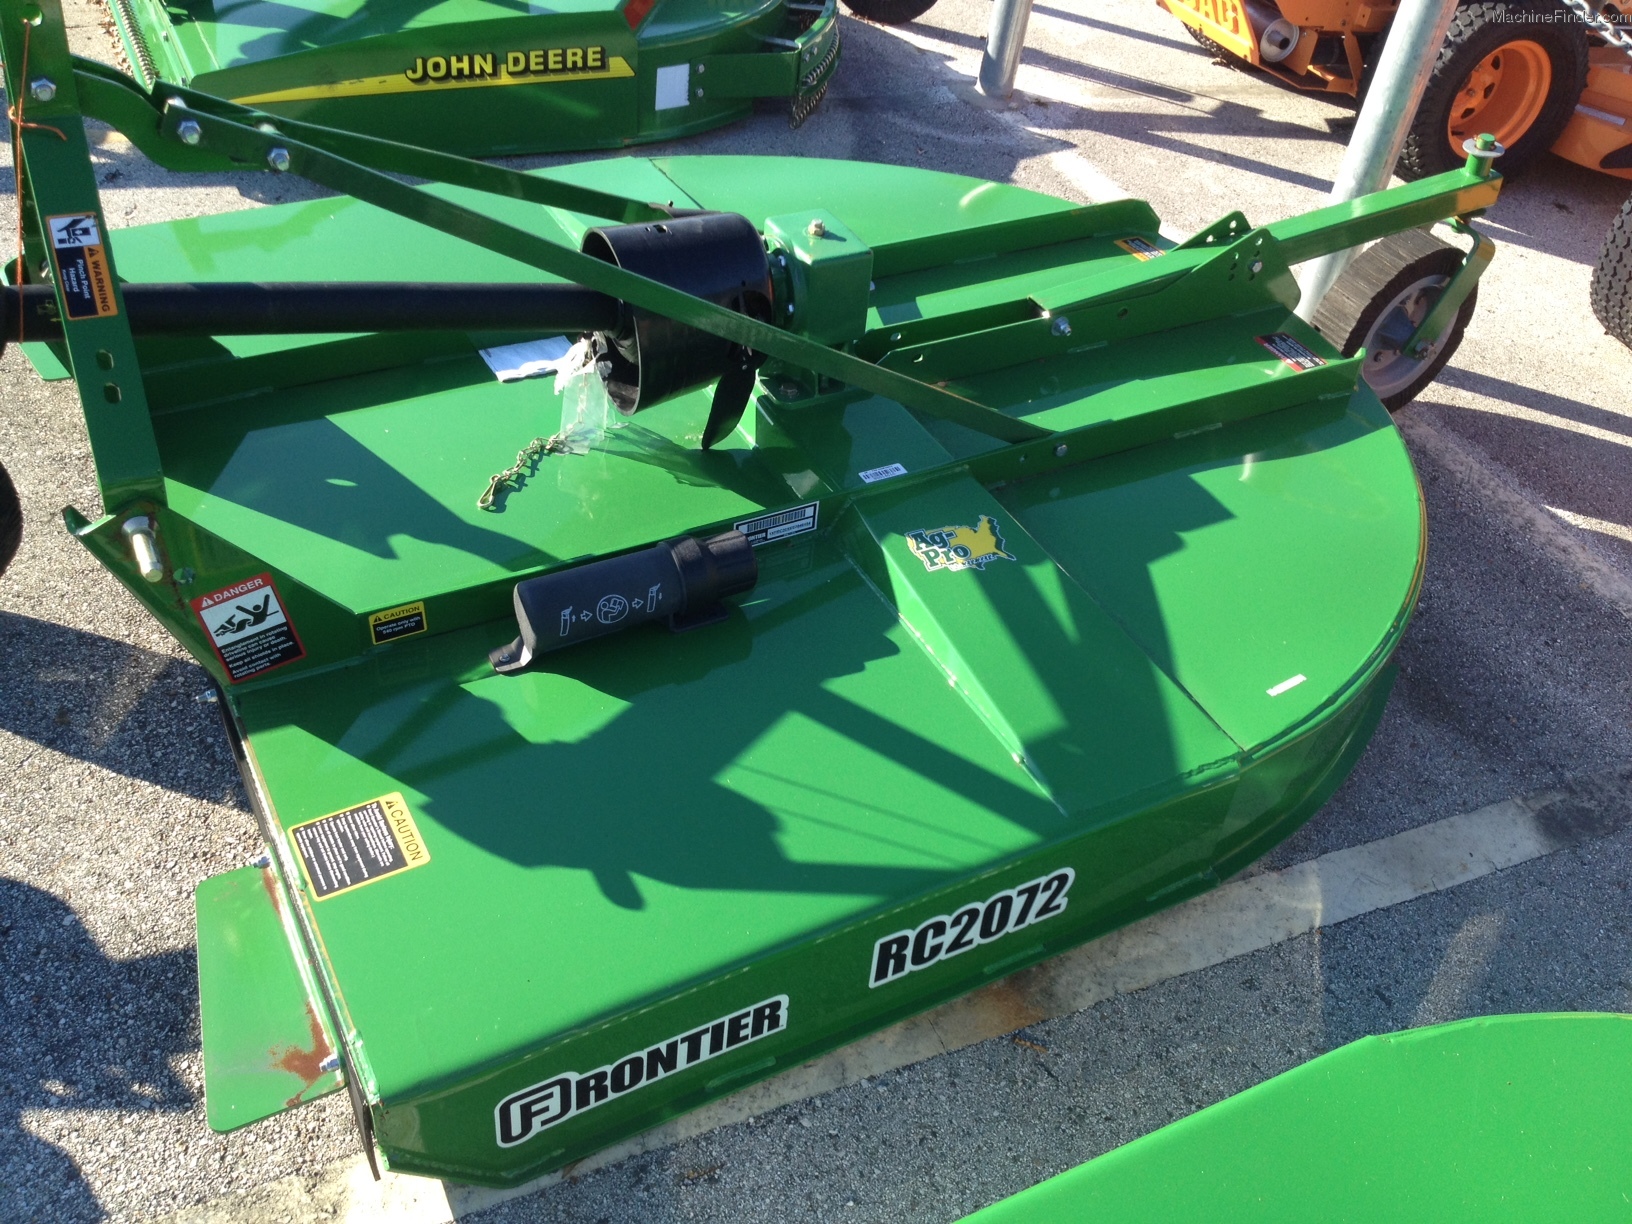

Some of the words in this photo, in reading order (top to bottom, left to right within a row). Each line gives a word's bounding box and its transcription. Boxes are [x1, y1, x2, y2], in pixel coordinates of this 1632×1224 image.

[405, 53, 495, 81] JOHN
[506, 46, 603, 74] DEERE
[69, 267, 80, 293] Hazard
[76, 259, 86, 279] Pinch
[82, 280, 90, 299] Point
[92, 260, 110, 312] WARNING
[921, 545, 971, 568] Pro
[213, 578, 264, 602] DANGER
[383, 606, 420, 620] CAUTION
[390, 809, 423, 861] CAUTION
[872, 871, 1071, 984] RC2072
[498, 997, 787, 1146] FRONTIER
